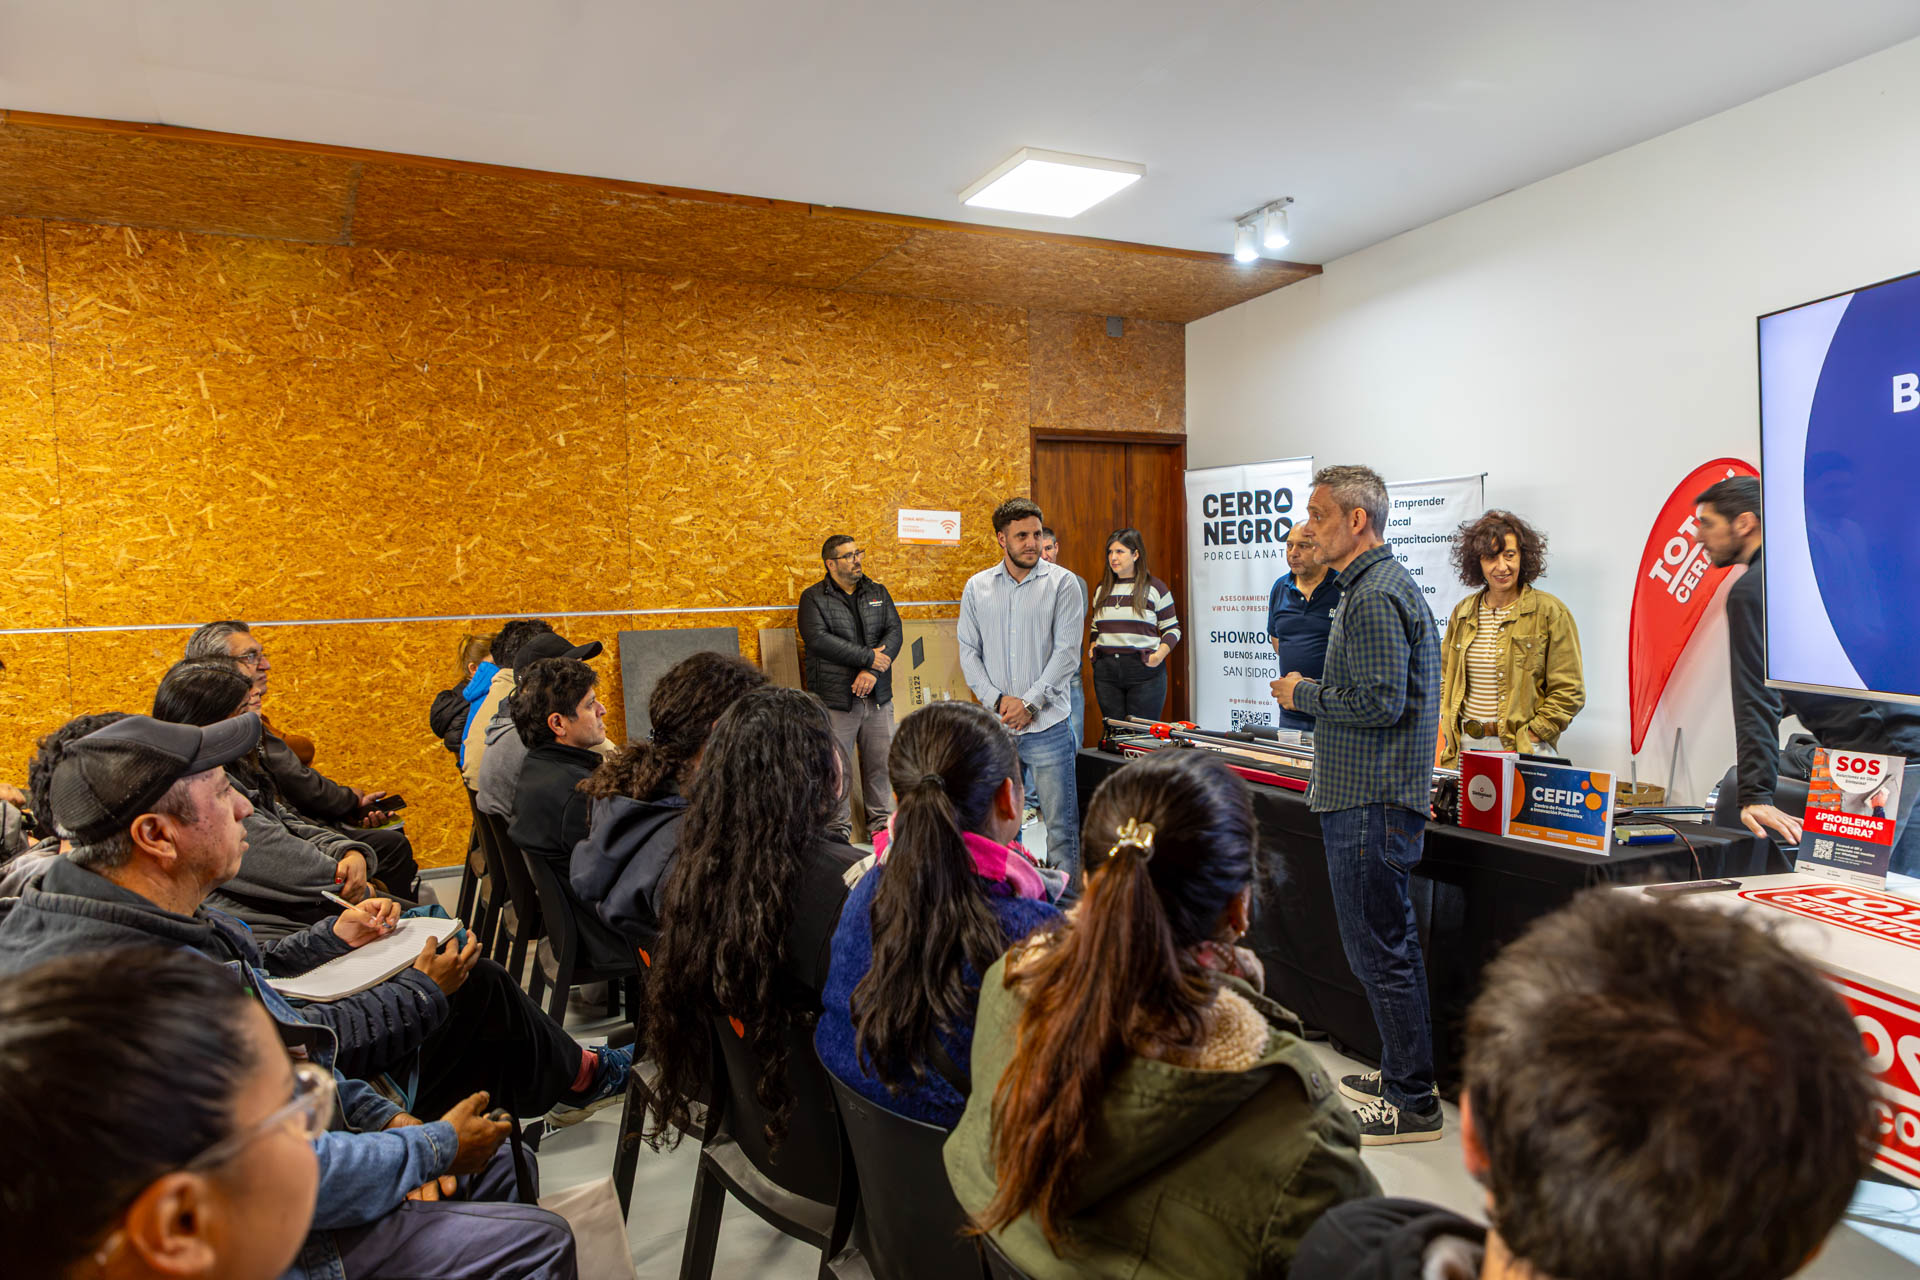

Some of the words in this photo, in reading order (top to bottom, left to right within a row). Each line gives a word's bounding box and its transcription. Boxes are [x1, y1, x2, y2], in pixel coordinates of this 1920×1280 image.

[1203, 488, 1293, 518] CERRO
[1394, 497, 1445, 510] Emprender
[1388, 517, 1411, 526] Local
[1204, 517, 1292, 546] NEGRO
[1387, 533, 1458, 547] capacitaciones
[1648, 509, 1702, 584] TOT
[1204, 549, 1285, 560] PORCELLANAT
[1409, 566, 1424, 576] cal
[1421, 585, 1436, 594] leo
[1210, 631, 1273, 644] SHOWRO
[1224, 651, 1253, 659] BUENOS
[1254, 652, 1277, 660] AIRES
[1223, 666, 1243, 677] SAN
[1245, 667, 1277, 678] ISIDRO
[1836, 756, 1880, 775] SOS
[1531, 786, 1585, 806] CEFIP
[1815, 812, 1884, 831] ¿PROBLEMAS
[1822, 823, 1837, 832] EN
[1838, 825, 1874, 838] OBRA?
[1772, 895, 1920, 940] CERAMIC
